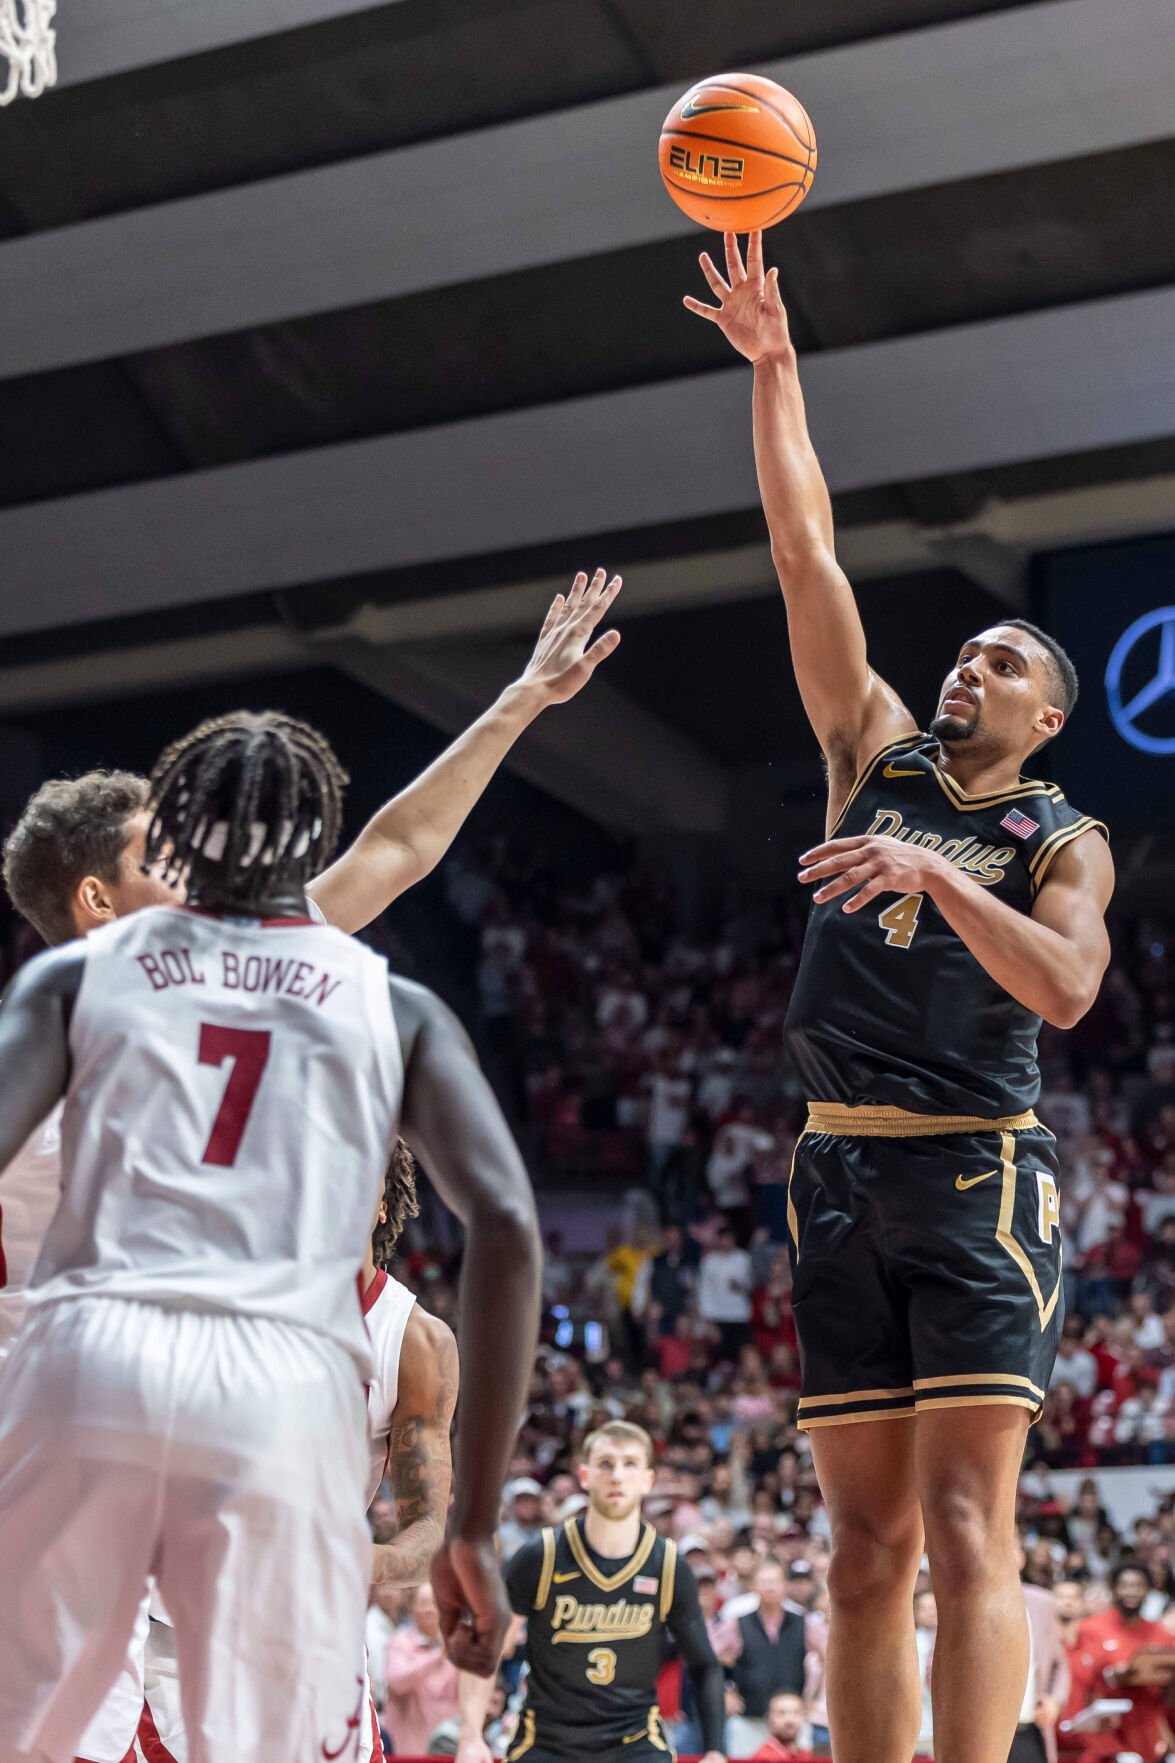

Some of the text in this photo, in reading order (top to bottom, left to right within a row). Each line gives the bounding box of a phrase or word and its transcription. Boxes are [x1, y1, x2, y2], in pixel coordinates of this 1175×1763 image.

[669, 144, 745, 181] ELITE
[865, 809, 1017, 886] Purdue
[878, 893, 924, 950] 4
[136, 948, 342, 1007] BOL BOWEN
[197, 1021, 272, 1168] 7
[1035, 1171, 1060, 1245] P
[551, 1594, 656, 1645] Purdue
[586, 1647, 618, 1686] 3
